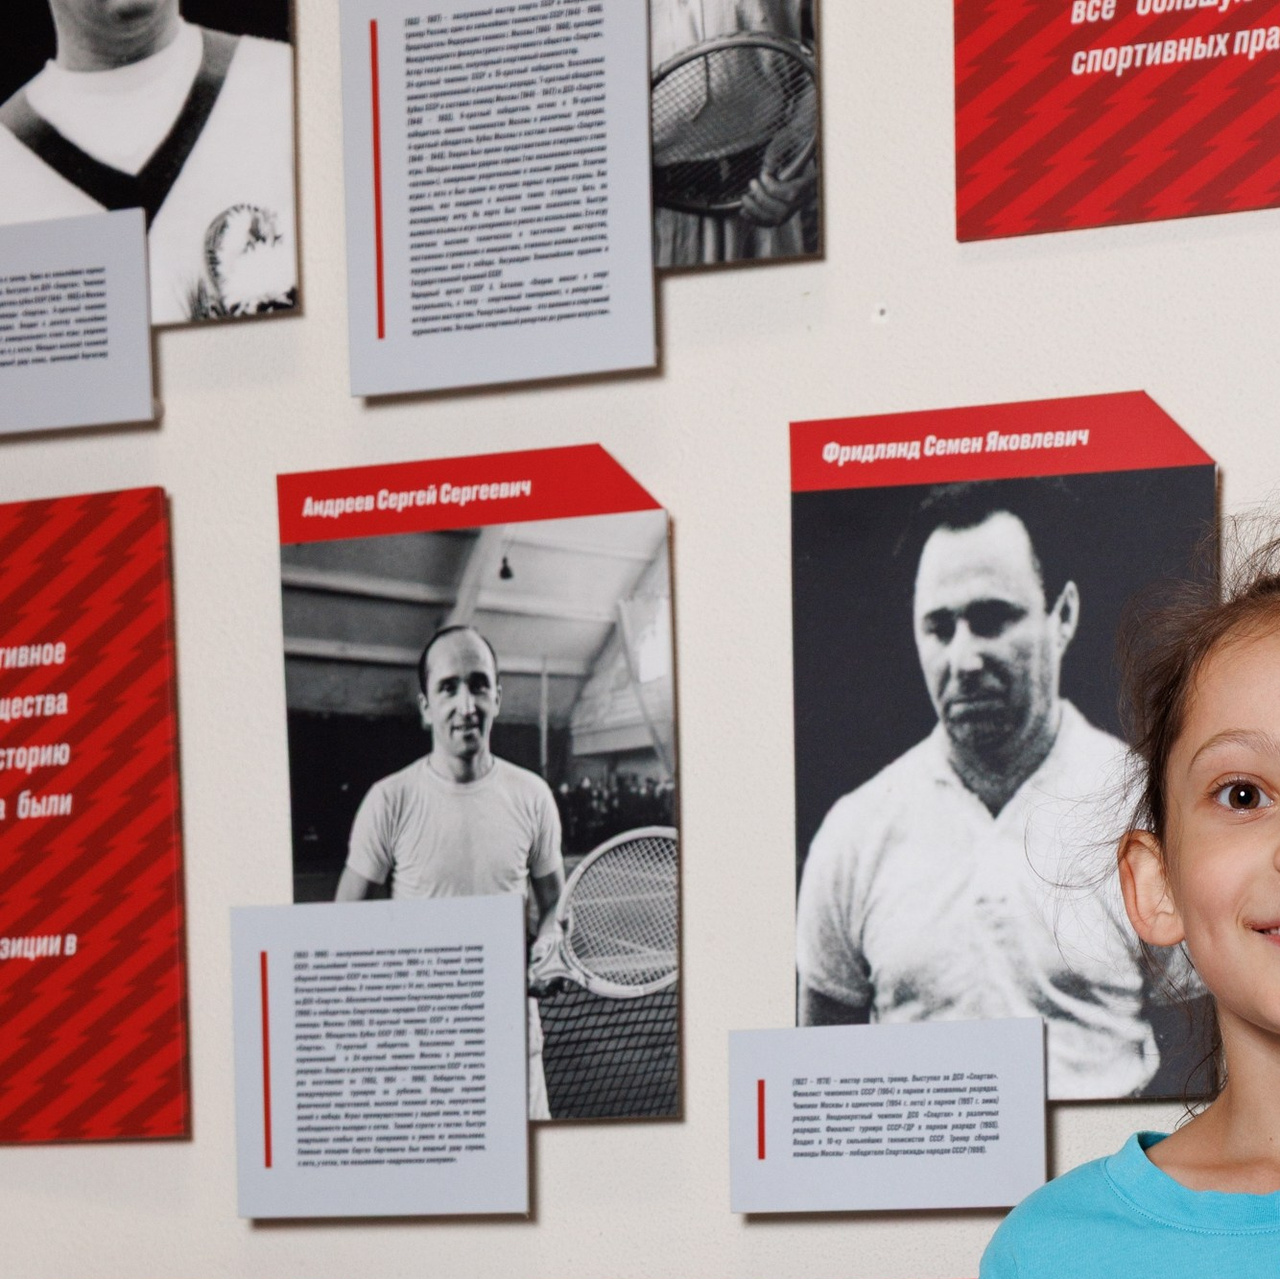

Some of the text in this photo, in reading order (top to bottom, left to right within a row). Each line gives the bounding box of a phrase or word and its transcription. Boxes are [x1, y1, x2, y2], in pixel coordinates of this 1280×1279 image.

[1071, 33, 1229, 75] спортивных
[822, 429, 1090, 466] Фридлянд Семен Яковлевич
[302, 480, 532, 518] Андреев Сергей Сергеевич
[17, 789, 72, 819] были
[64, 933, 77, 956] в
